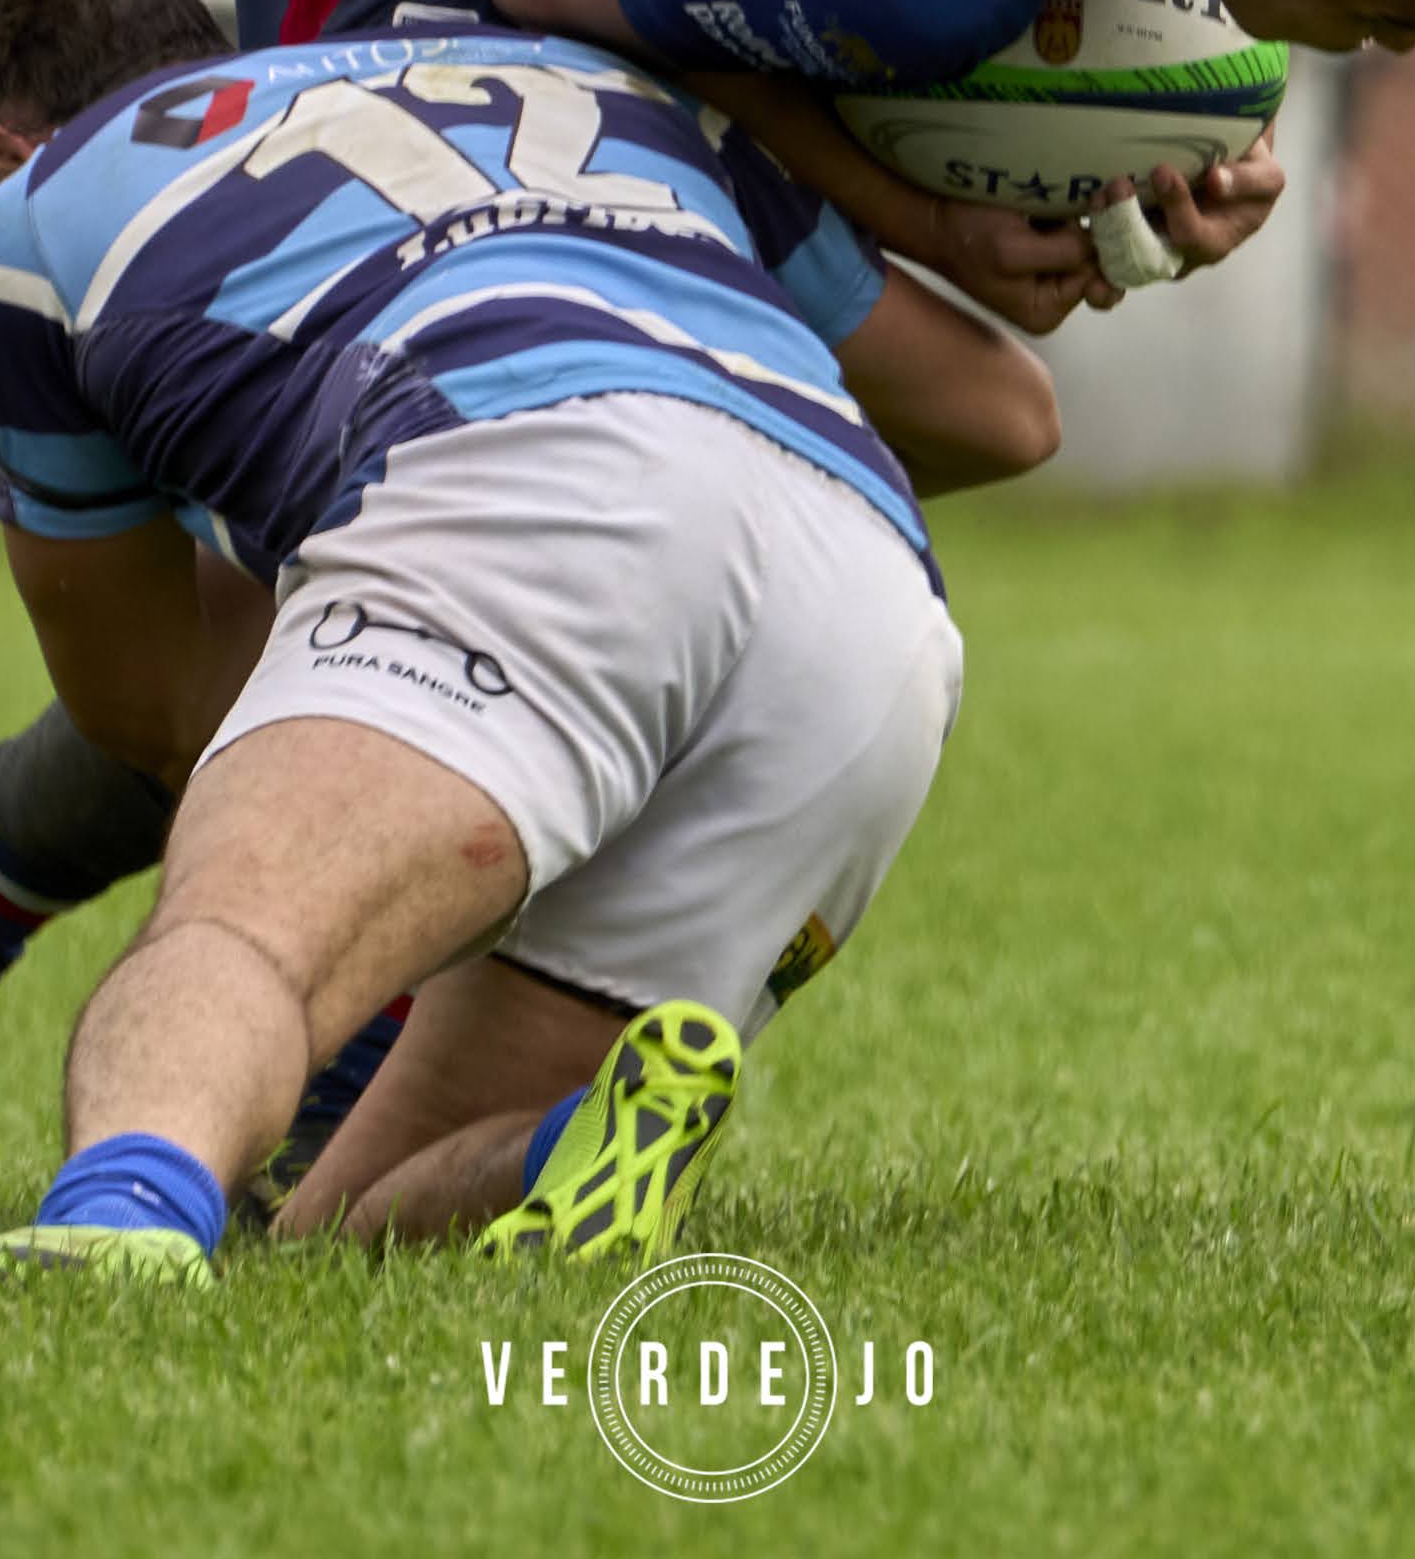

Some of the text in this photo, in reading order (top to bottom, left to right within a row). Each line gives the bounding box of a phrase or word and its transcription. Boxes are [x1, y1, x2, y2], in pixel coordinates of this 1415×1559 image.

[242, 64, 684, 226] 12
[312, 653, 486, 715] PURA SANGRE
